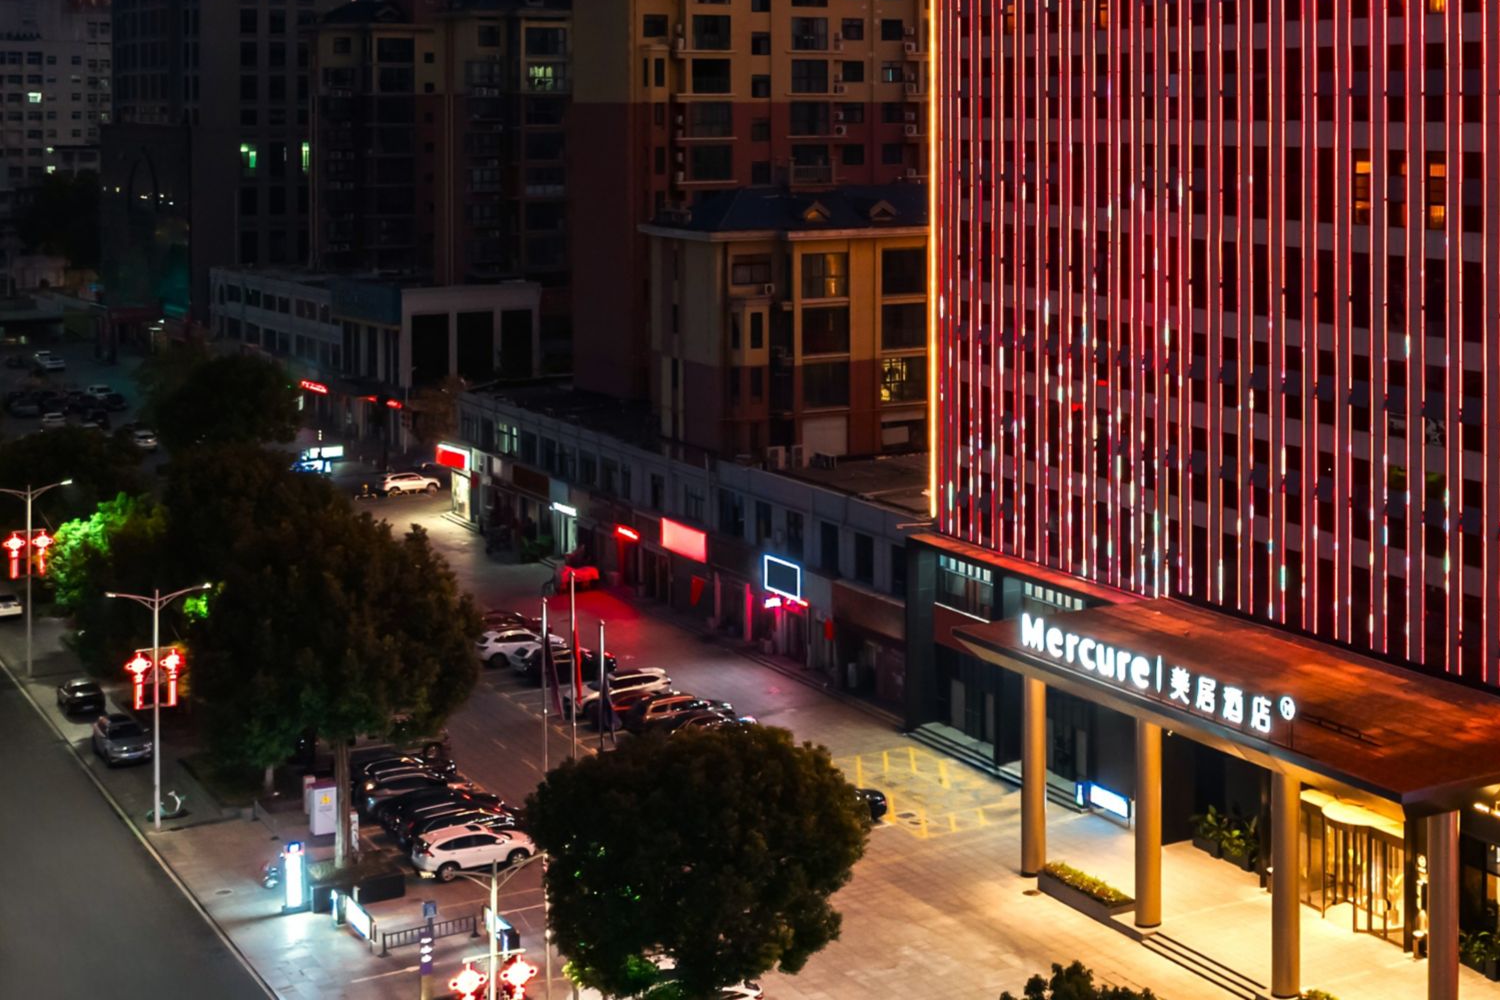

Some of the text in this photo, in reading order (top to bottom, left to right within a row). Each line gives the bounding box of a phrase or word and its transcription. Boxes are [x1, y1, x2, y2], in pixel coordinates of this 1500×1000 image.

[1021, 613, 1272, 733] Mercure 美居酒店
